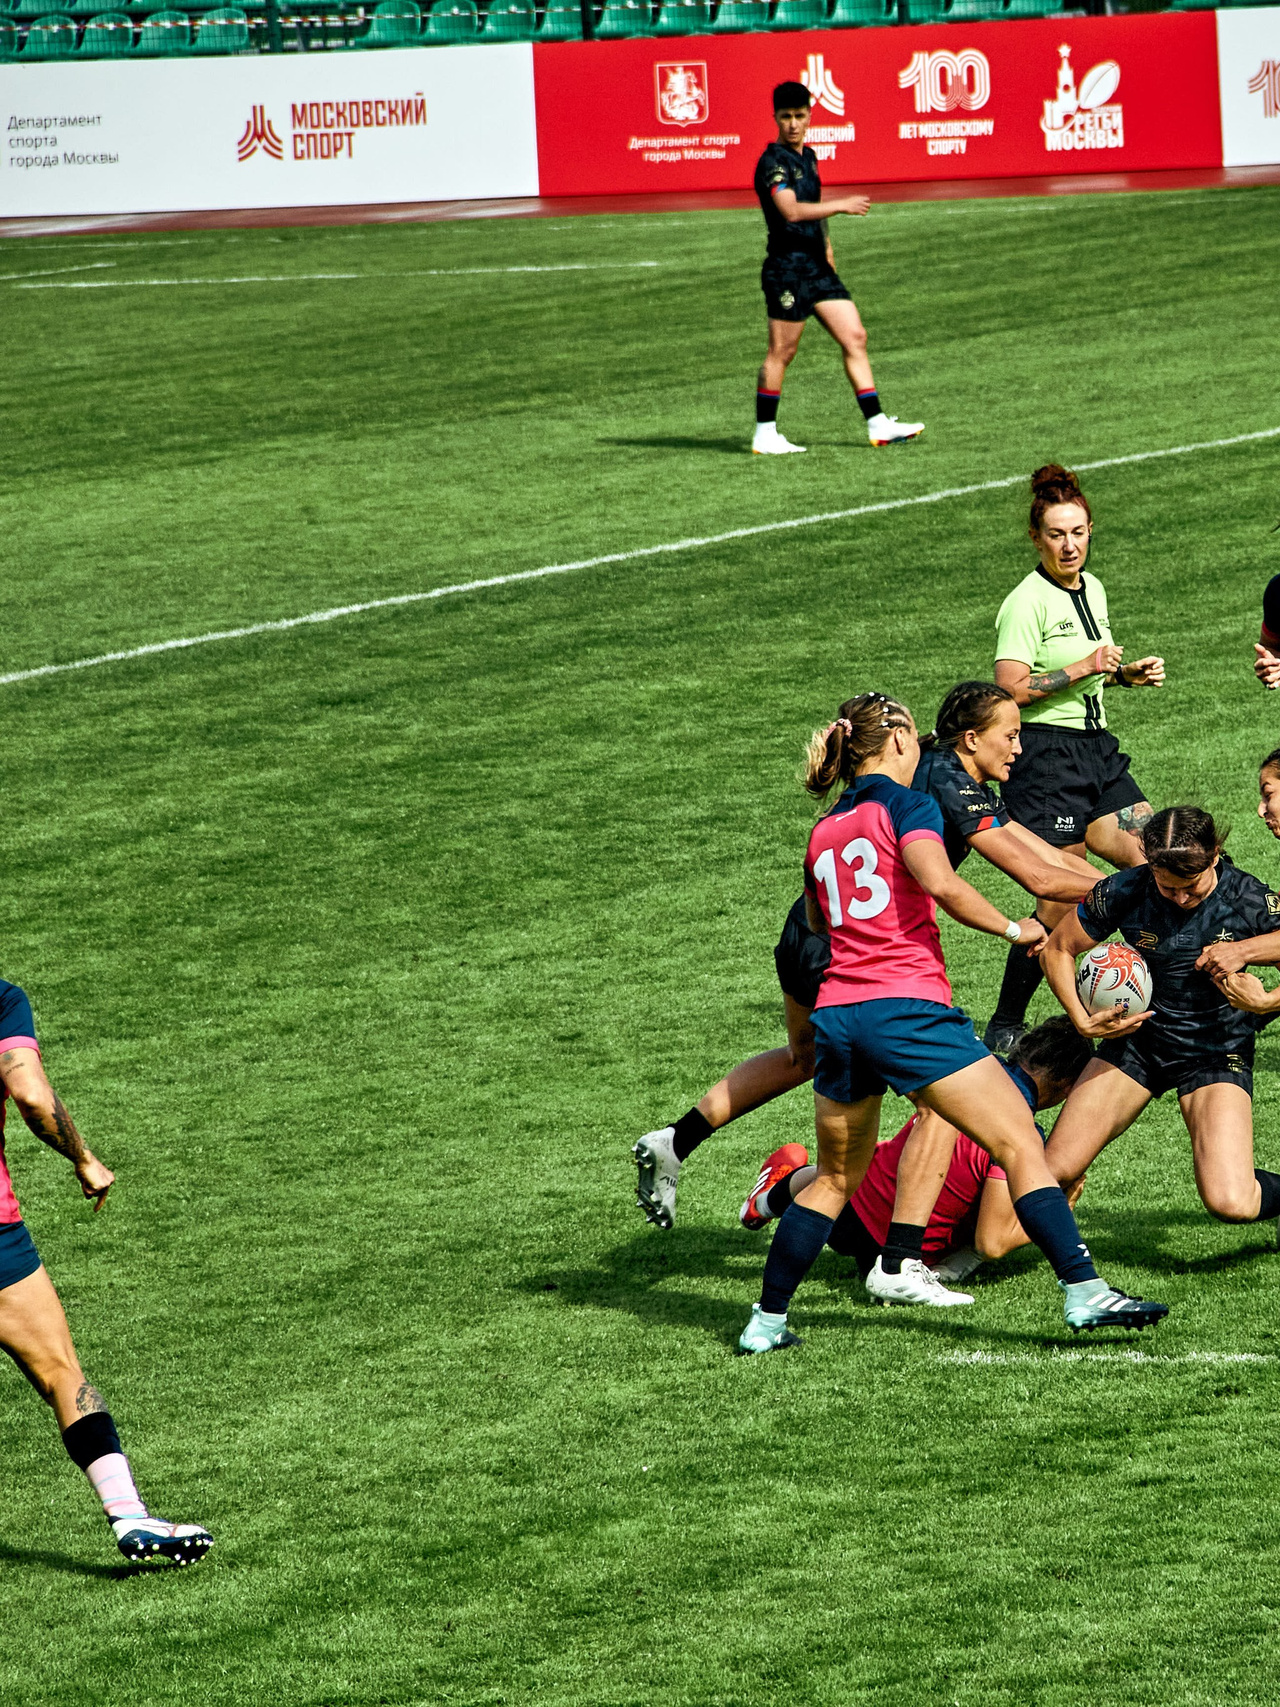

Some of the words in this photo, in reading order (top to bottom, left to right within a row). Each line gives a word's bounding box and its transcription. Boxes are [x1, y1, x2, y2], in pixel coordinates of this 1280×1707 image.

[898, 47, 991, 114] 100
[291, 92, 427, 130] МОСКОВСКИЙ
[1074, 111, 1123, 131] РЕГБИ
[7, 115, 103, 131] Департамент
[899, 121, 918, 139] ЛЕТ
[918, 119, 995, 138] МОСКОВСКОМУ
[8, 135, 58, 150] спорта
[292, 131, 355, 161] СПОРТ
[630, 134, 701, 151] Департамент
[703, 133, 740, 147] спорта
[927, 137, 967, 156] СПОРТУ
[1046, 129, 1125, 152] МОСКВЫ
[9, 154, 60, 169] города
[62, 151, 120, 165] Москвы
[644, 150, 682, 163] города
[683, 148, 726, 161] Москвы
[813, 837, 891, 928] 13
